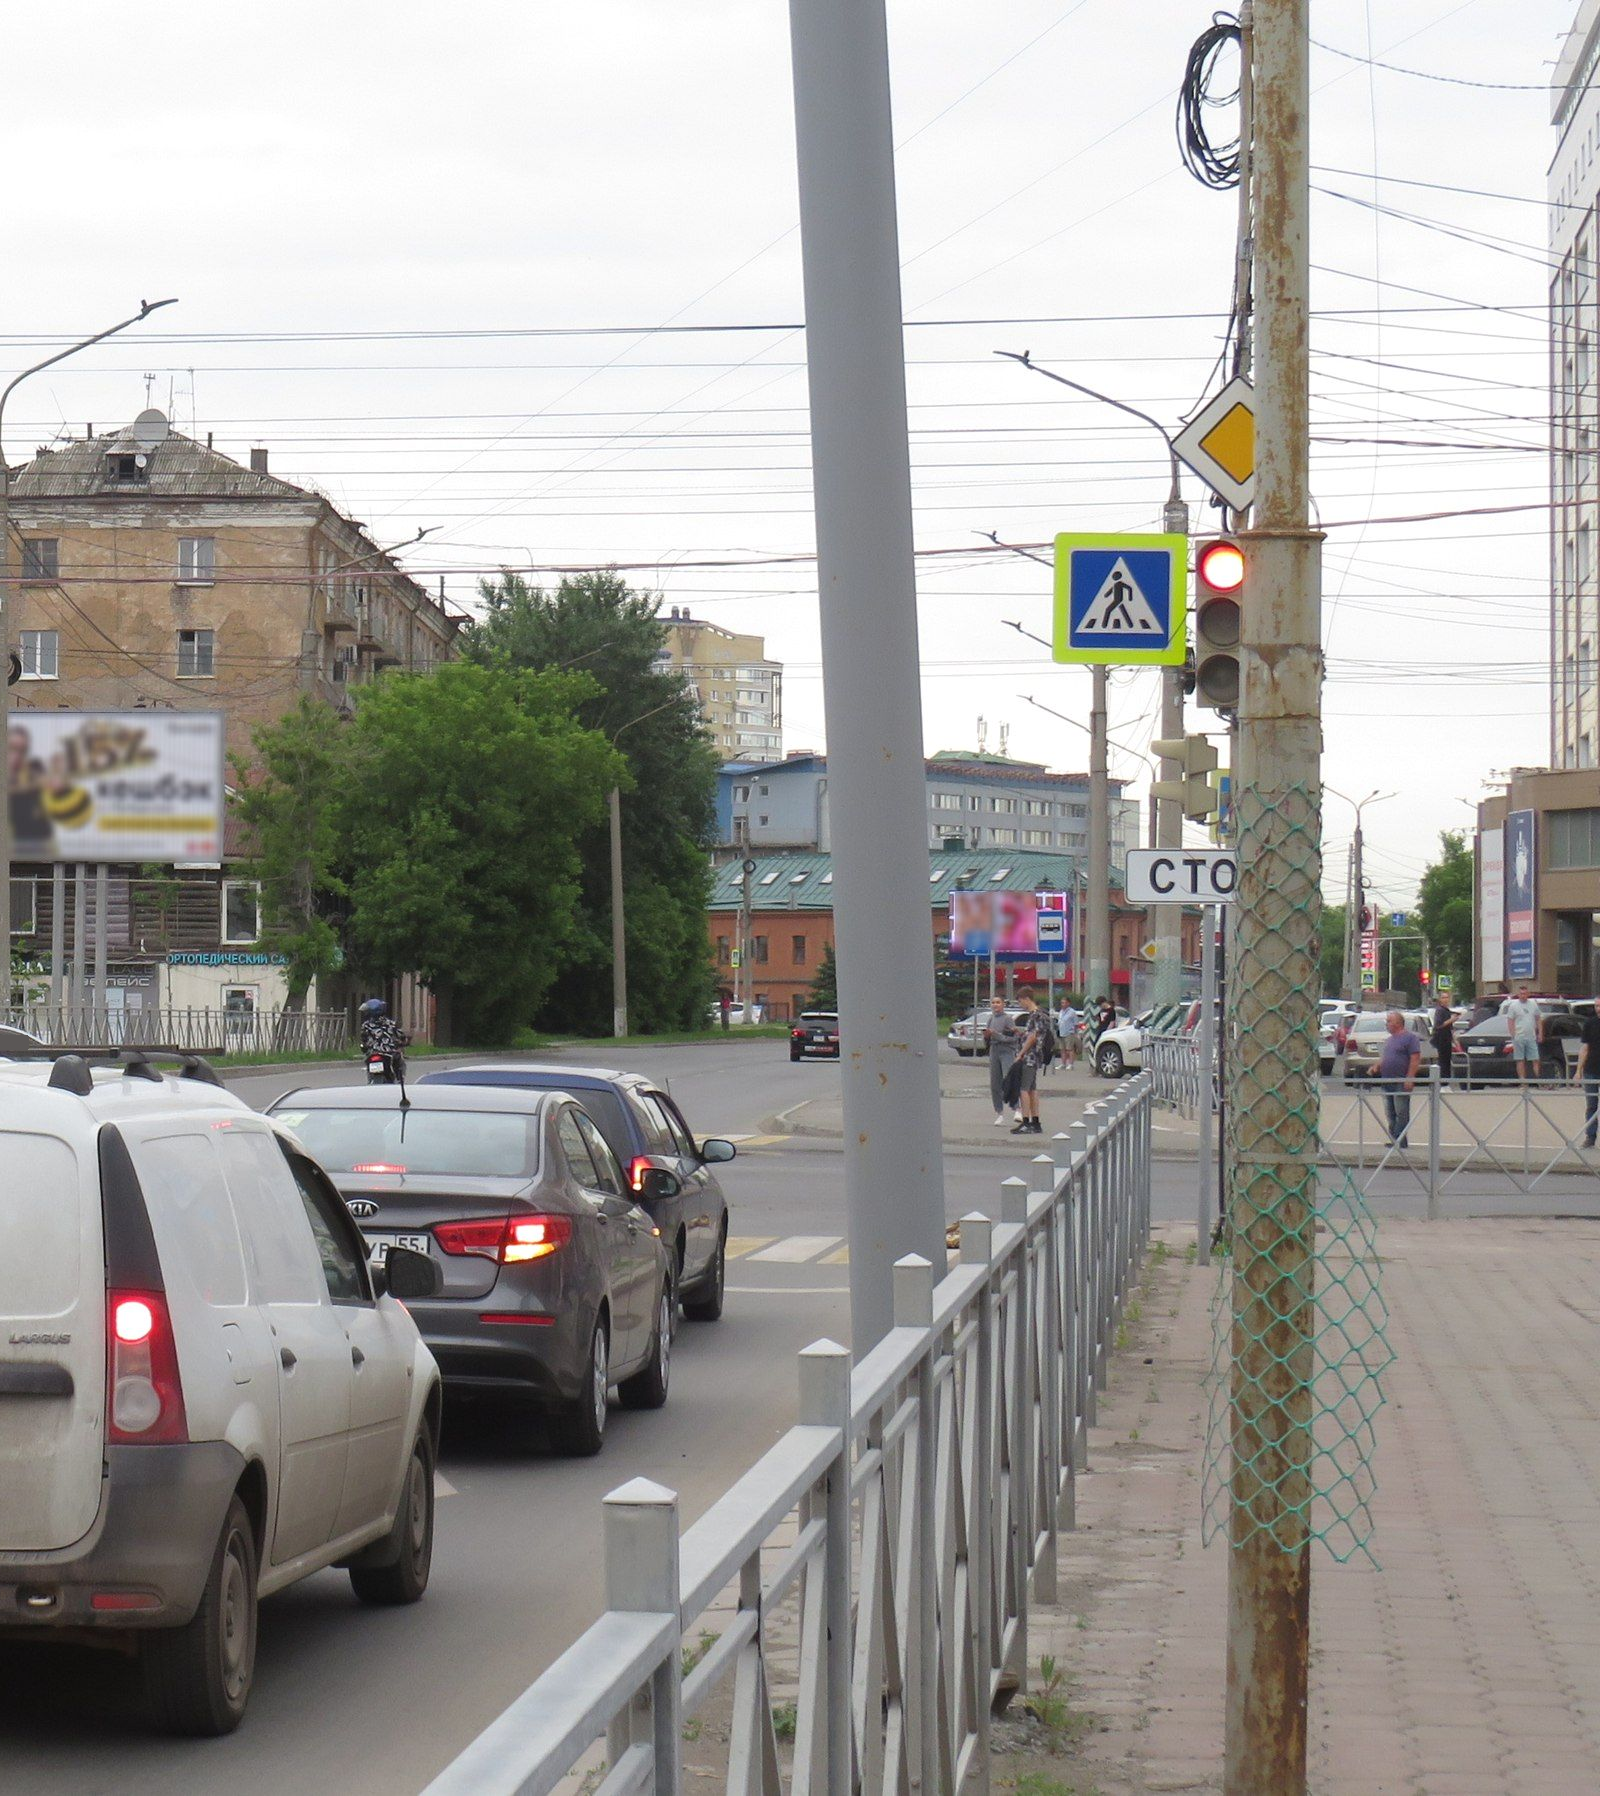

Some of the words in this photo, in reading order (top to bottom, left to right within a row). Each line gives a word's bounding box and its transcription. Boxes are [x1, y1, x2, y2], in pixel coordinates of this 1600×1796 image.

[1150, 858, 1237, 894] СТО
[166, 952, 267, 967] ОРТОПЕДИЧЕСКИЙ
[348, 1203, 374, 1216] KIA
[8, 1333, 71, 1345] LARGUS
